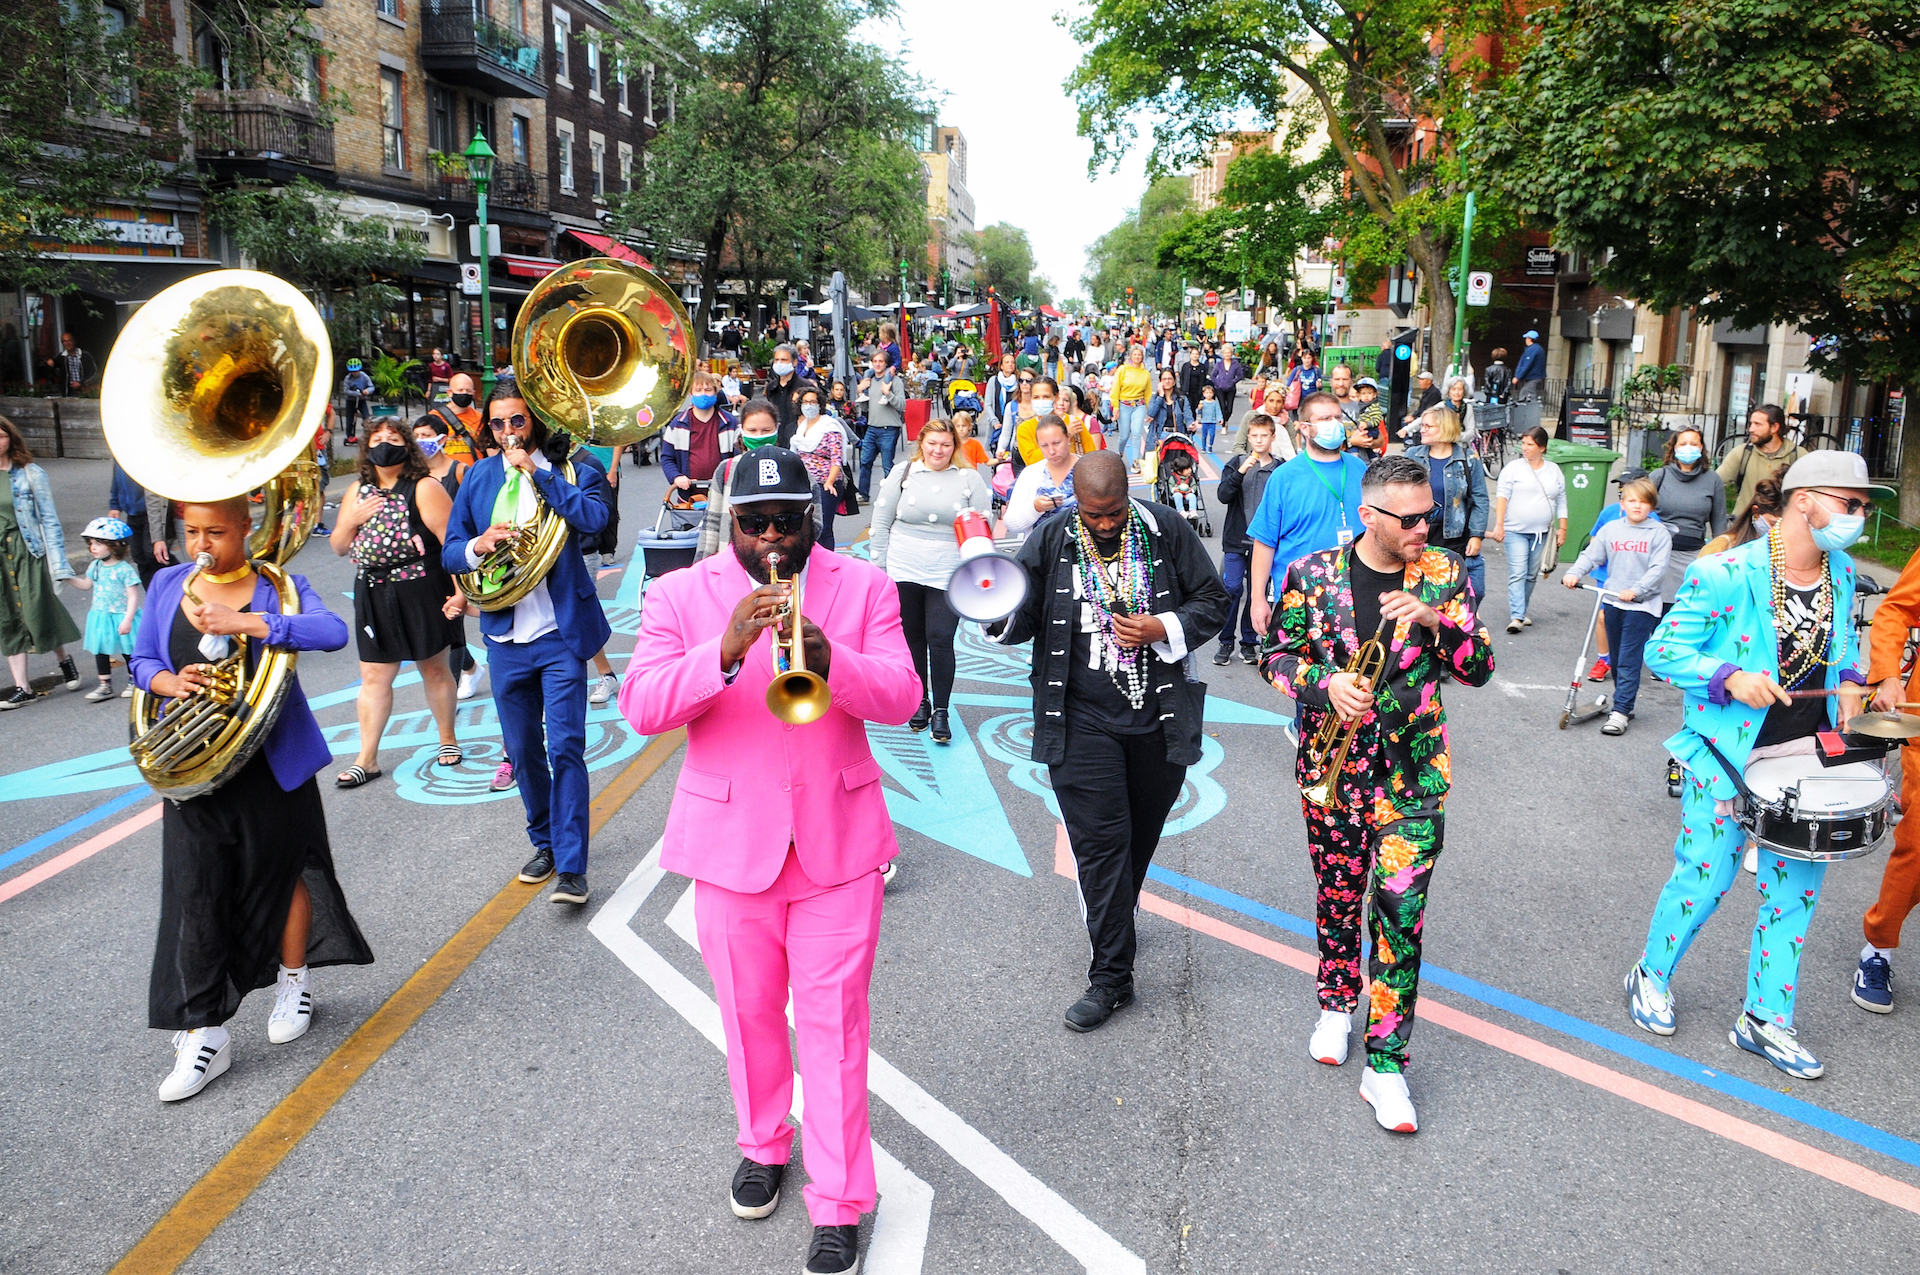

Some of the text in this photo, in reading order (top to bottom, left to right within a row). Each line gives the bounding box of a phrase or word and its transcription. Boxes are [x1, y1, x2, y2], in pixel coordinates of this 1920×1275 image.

[1527, 249, 1556, 263] Sutton
[758, 458, 781, 486] B
[1610, 540, 1649, 553] McGill
